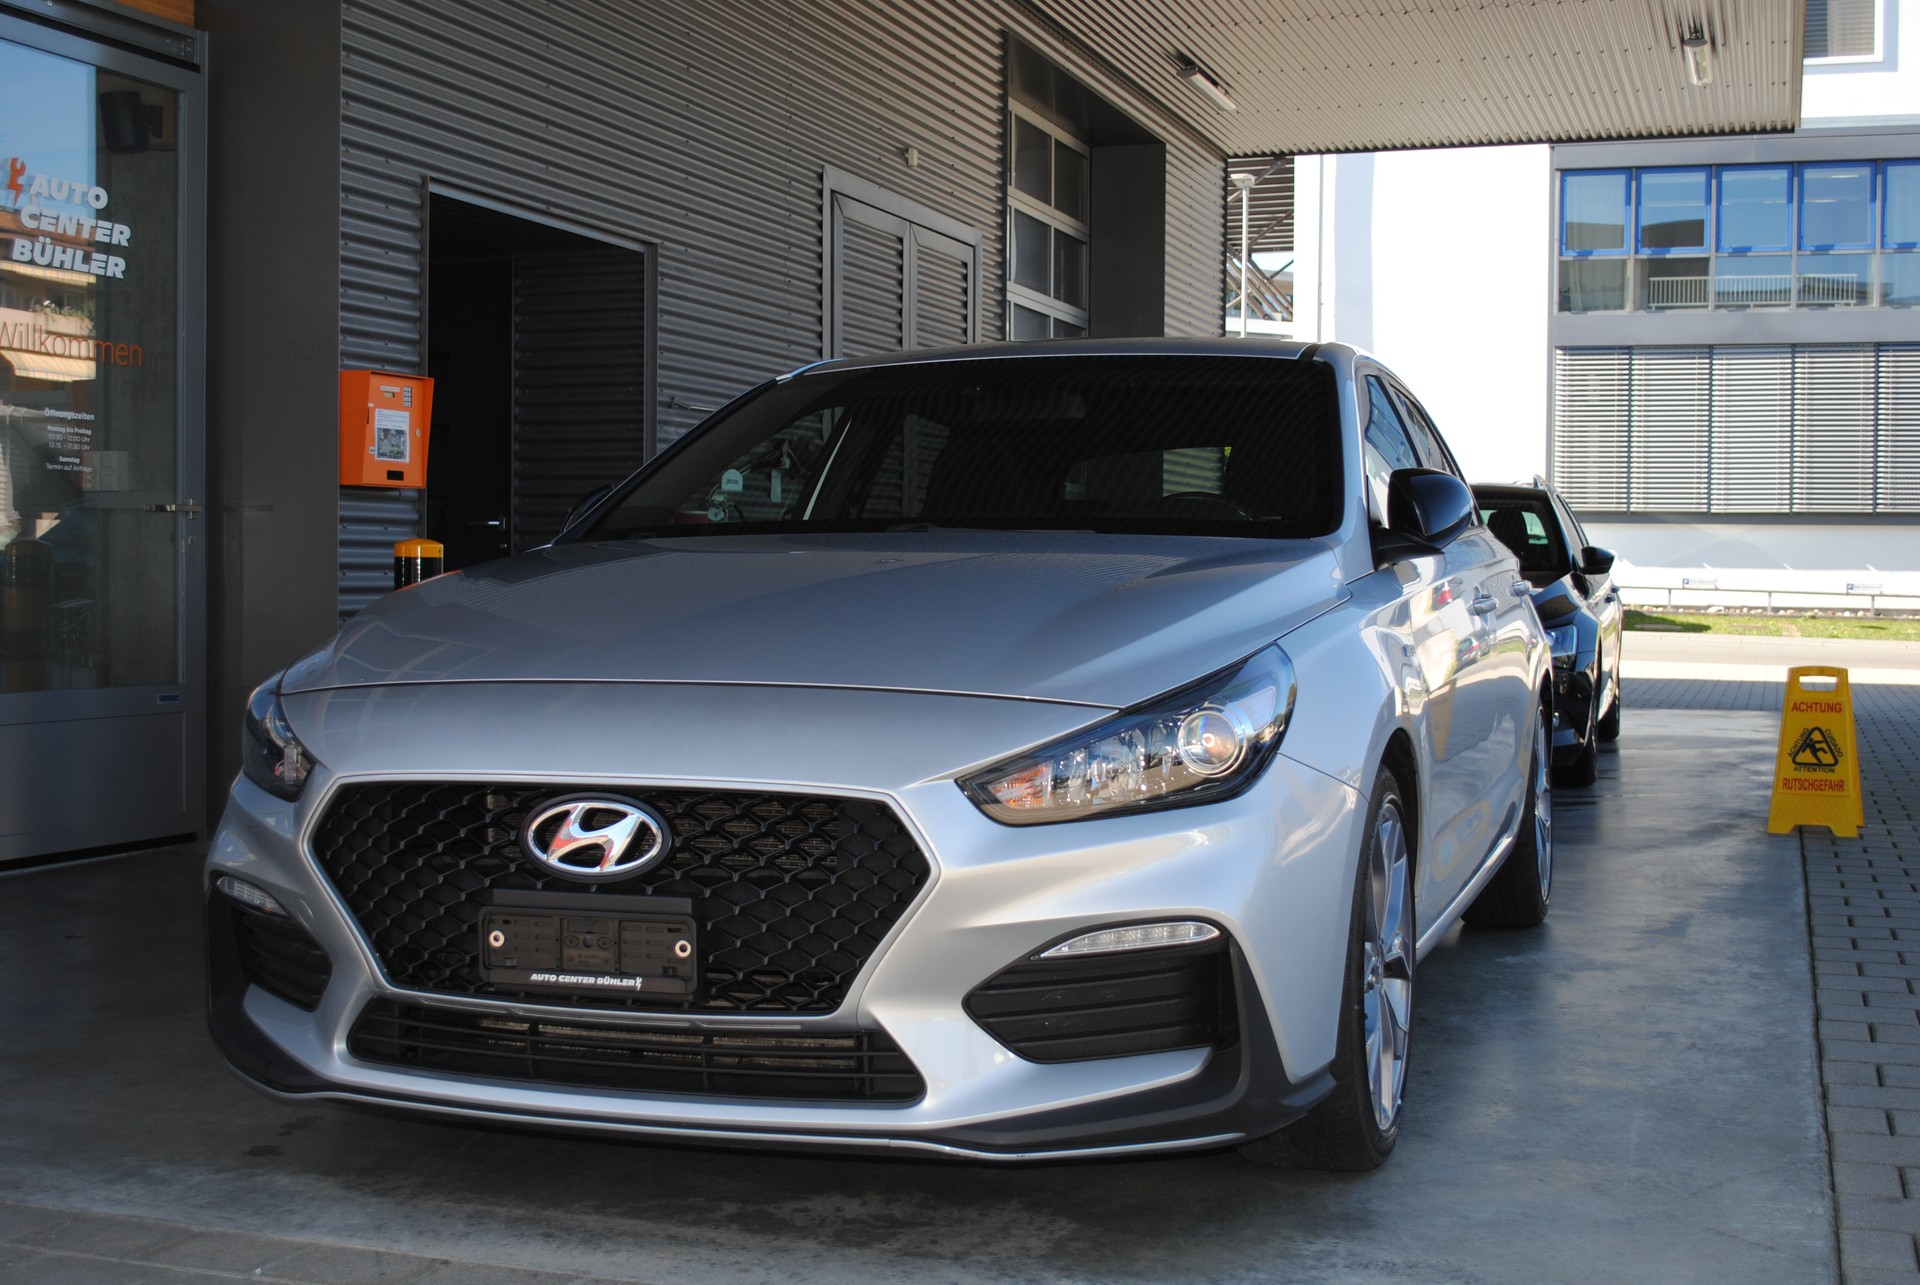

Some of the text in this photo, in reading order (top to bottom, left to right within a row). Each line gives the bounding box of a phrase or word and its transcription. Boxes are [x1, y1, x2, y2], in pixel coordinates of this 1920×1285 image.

[30, 174, 108, 209] AUTO
[20, 205, 131, 247] CENTER
[12, 236, 126, 279] BÜHLER
[0, 321, 143, 368] Willkommen
[45, 407, 94, 420] Öffnungszeiten
[1791, 701, 1842, 714] ACHTUNG
[1788, 727, 1809, 758] ACHTUNG
[1825, 729, 1843, 758] CUIDADO
[1782, 777, 1845, 792] RUTSCHGEFAHR
[530, 973, 635, 986] AUTO CENTER BÜHLER
